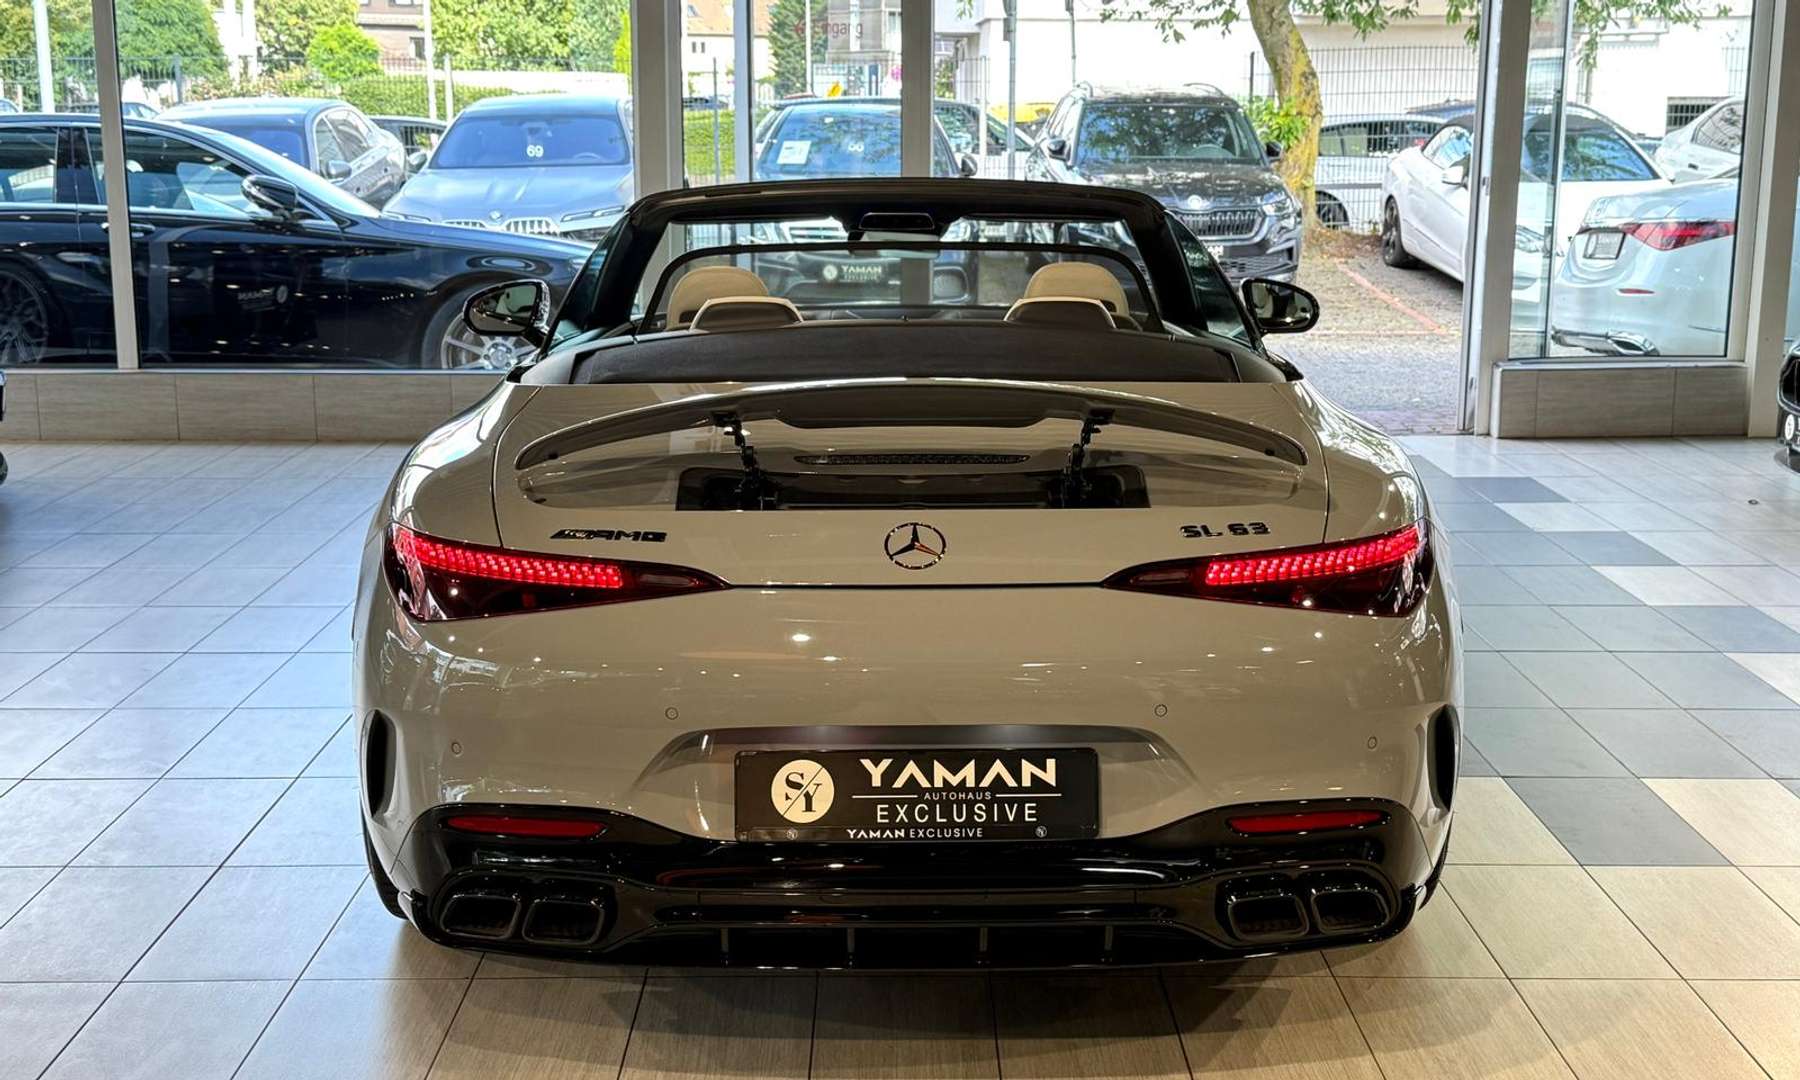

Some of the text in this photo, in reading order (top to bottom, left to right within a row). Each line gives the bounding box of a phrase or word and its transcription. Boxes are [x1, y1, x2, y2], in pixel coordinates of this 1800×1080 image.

[812, 18, 864, 39] ngang
[526, 144, 544, 158] 69
[841, 264, 882, 273] YAMAN
[591, 528, 668, 543] AMG
[1180, 522, 1271, 538] SL 63
[859, 758, 1057, 789] YAMAN
[923, 791, 992, 801] AUTOHAUS
[876, 803, 1038, 823] EXCLUSIVE
[846, 827, 984, 839] YAMAN EXCLUSIVE
